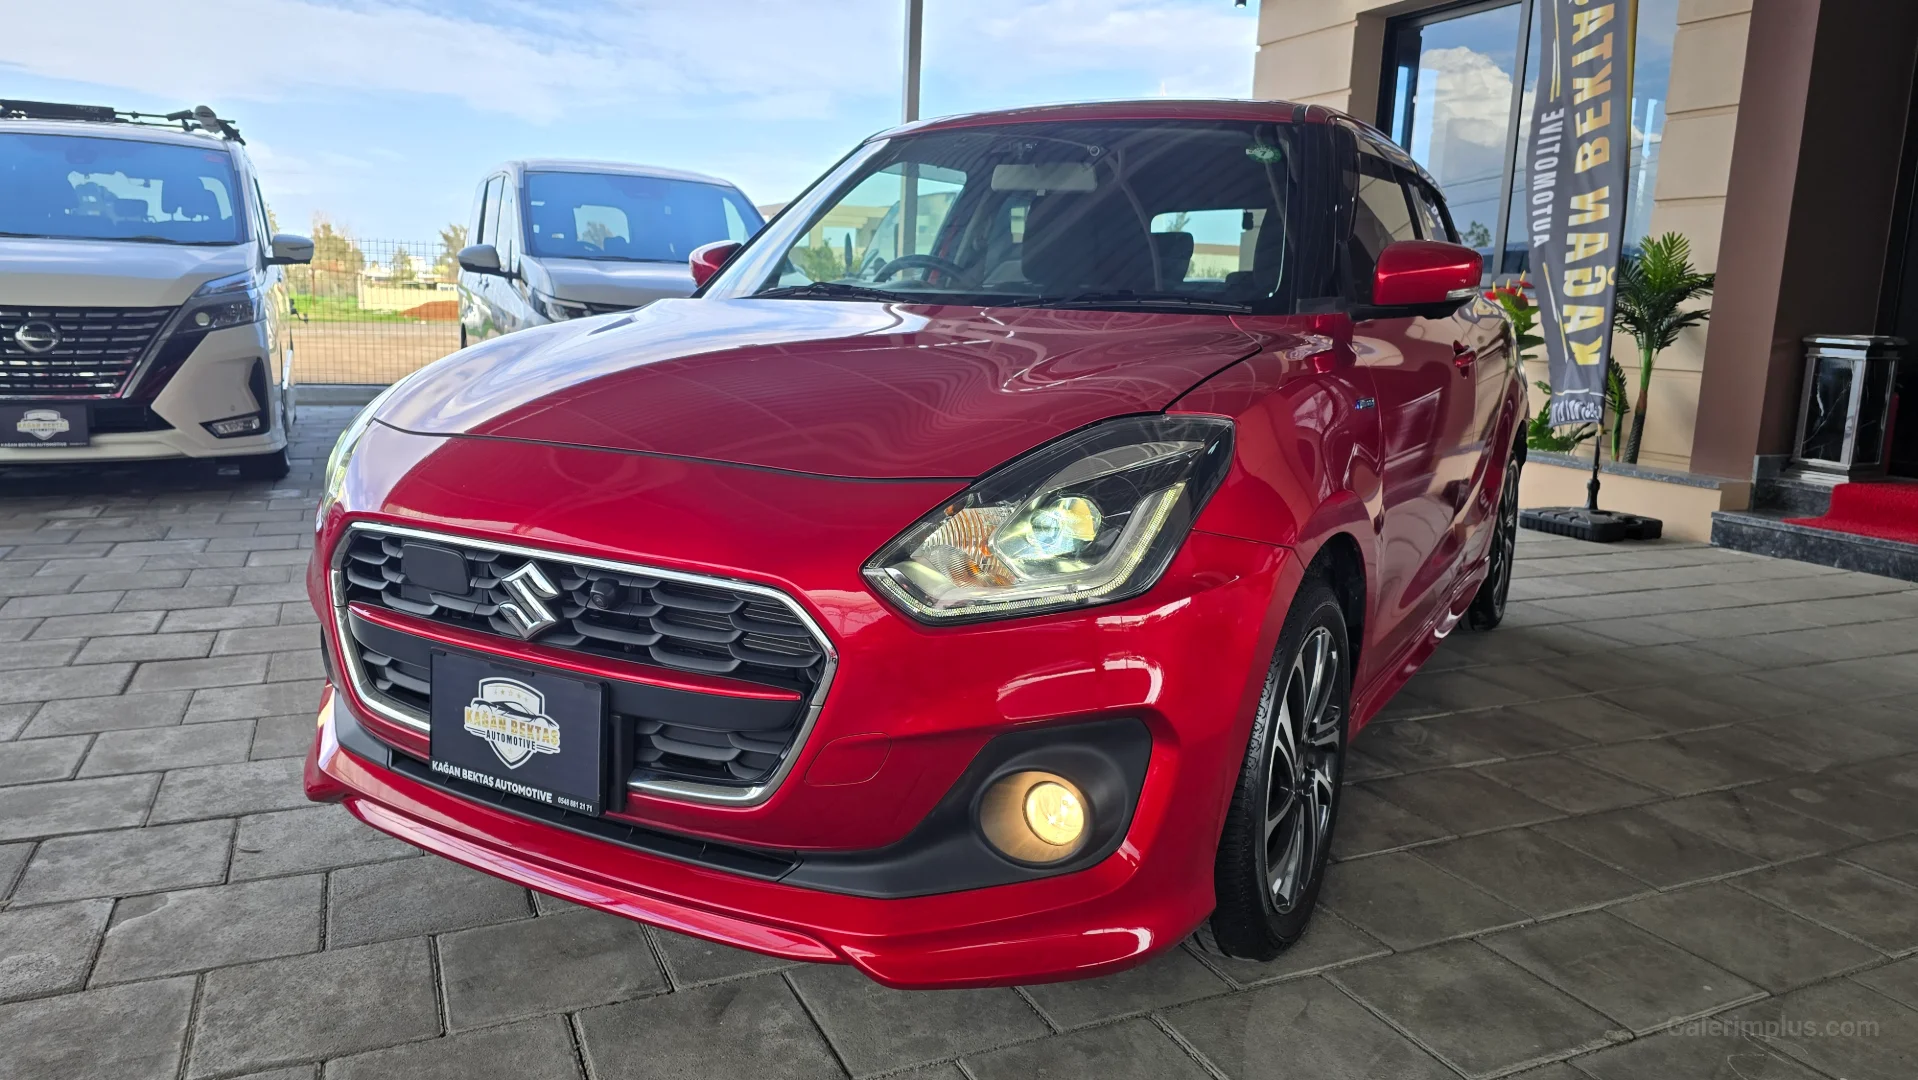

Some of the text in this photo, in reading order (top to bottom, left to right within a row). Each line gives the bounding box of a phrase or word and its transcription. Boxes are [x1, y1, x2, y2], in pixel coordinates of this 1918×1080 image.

[465, 708, 507, 733] KAĞAN
[486, 730, 536, 750] AUTOMOTIVE
[431, 760, 461, 778] KAĞAN
[462, 770, 494, 788] BEKTAŞ
[494, 778, 553, 803] AUTOMOTIVE
